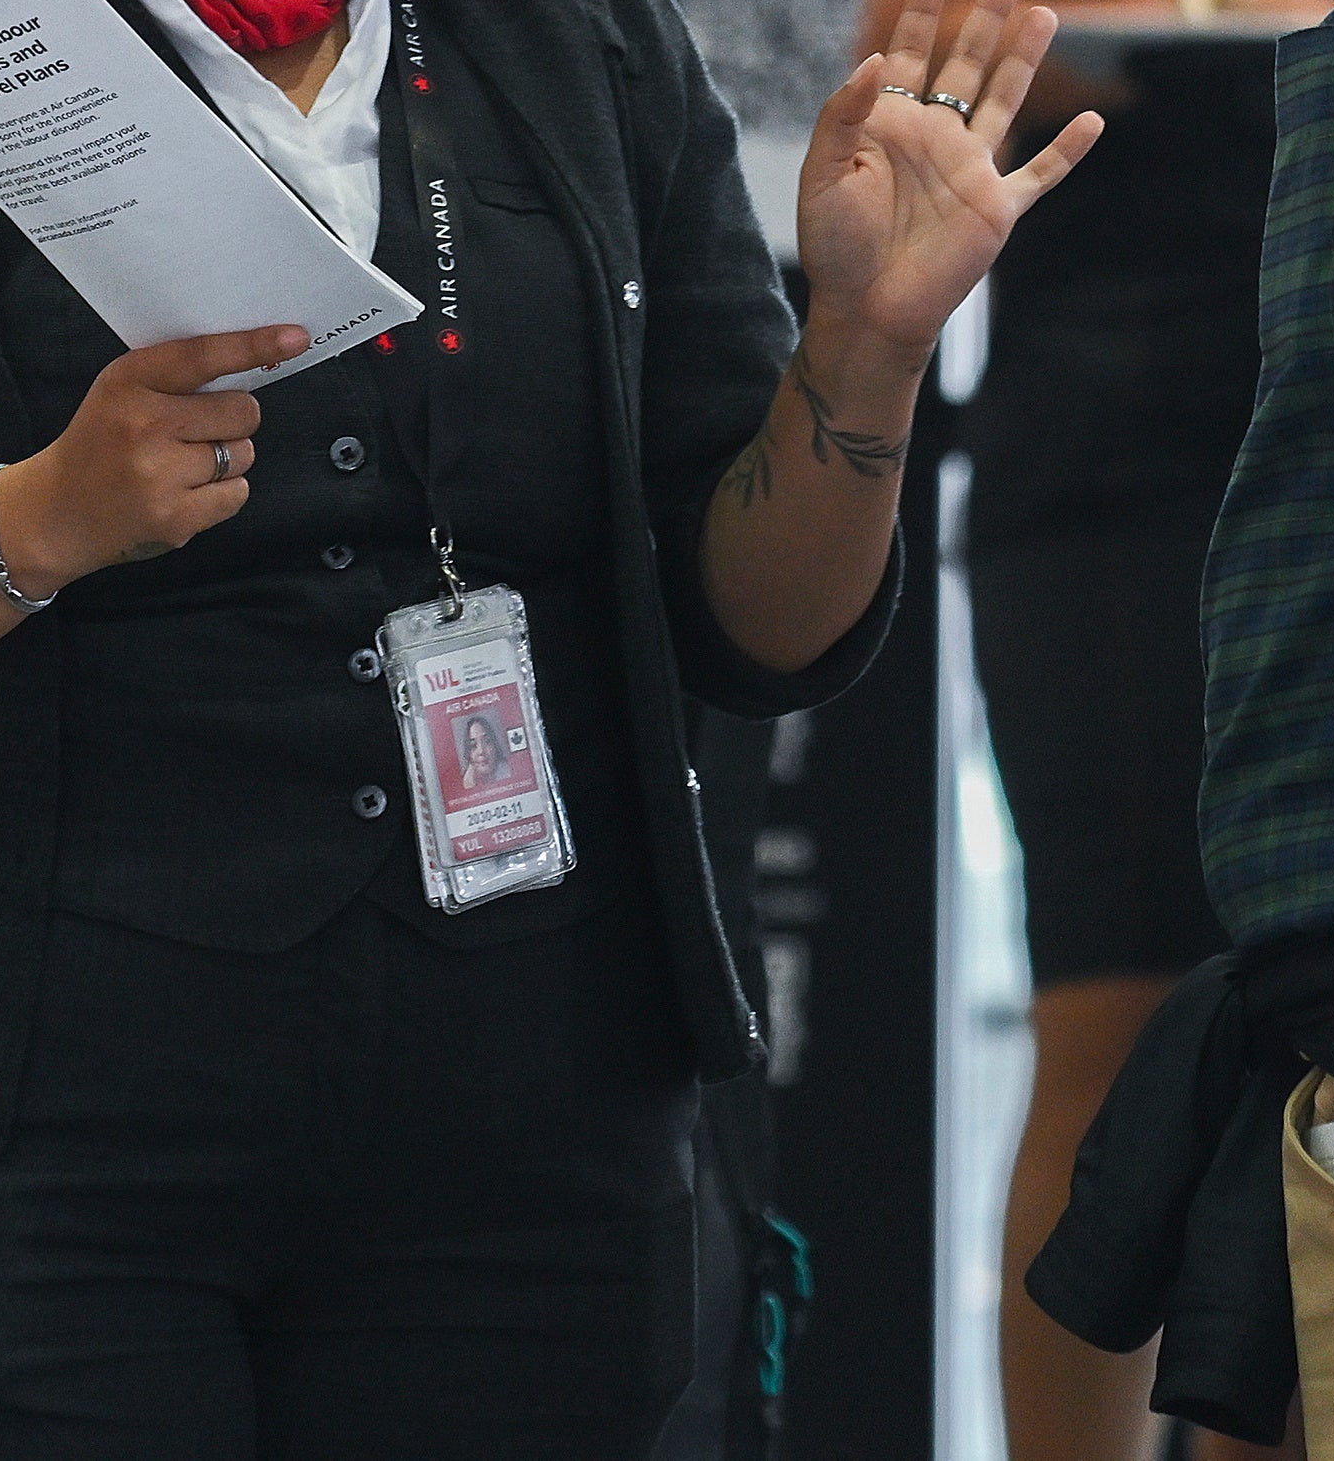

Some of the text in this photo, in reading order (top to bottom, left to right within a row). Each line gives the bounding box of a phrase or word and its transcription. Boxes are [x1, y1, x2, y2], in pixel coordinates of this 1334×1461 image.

[9, 39, 49, 65] and
[405, 33, 425, 68] AIR
[15, 58, 70, 88] Plans
[21, 125, 36, 134] for
[35, 118, 54, 129] the
[51, 91, 119, 123] inconvenience
[38, 106, 51, 116] at
[50, 100, 64, 111] Air
[63, 86, 104, 105] Canada,
[4, 141, 22, 152] the
[19, 132, 50, 147] labour
[50, 114, 101, 137] disruption.
[43, 152, 63, 164] this
[62, 145, 83, 158] may
[81, 133, 116, 151] impact
[114, 123, 137, 138] your
[13, 173, 39, 186] plans
[37, 168, 56, 179] and
[55, 159, 82, 173] we're
[80, 150, 104, 164] here
[102, 146, 115, 156] to
[114, 130, 152, 152] provide
[14, 185, 35, 197] with
[33, 181, 51, 192] the
[48, 176, 72, 187] best
[70, 161, 112, 181] available
[110, 146, 147, 166] options
[5, 194, 48, 210] for travel.
[28, 197, 139, 236] For the latest information visit
[427, 178, 459, 320] AIR CANADA
[313, 306, 384, 346] CANADA
[423, 667, 461, 692] YUL
[457, 837, 484, 853] YUL
